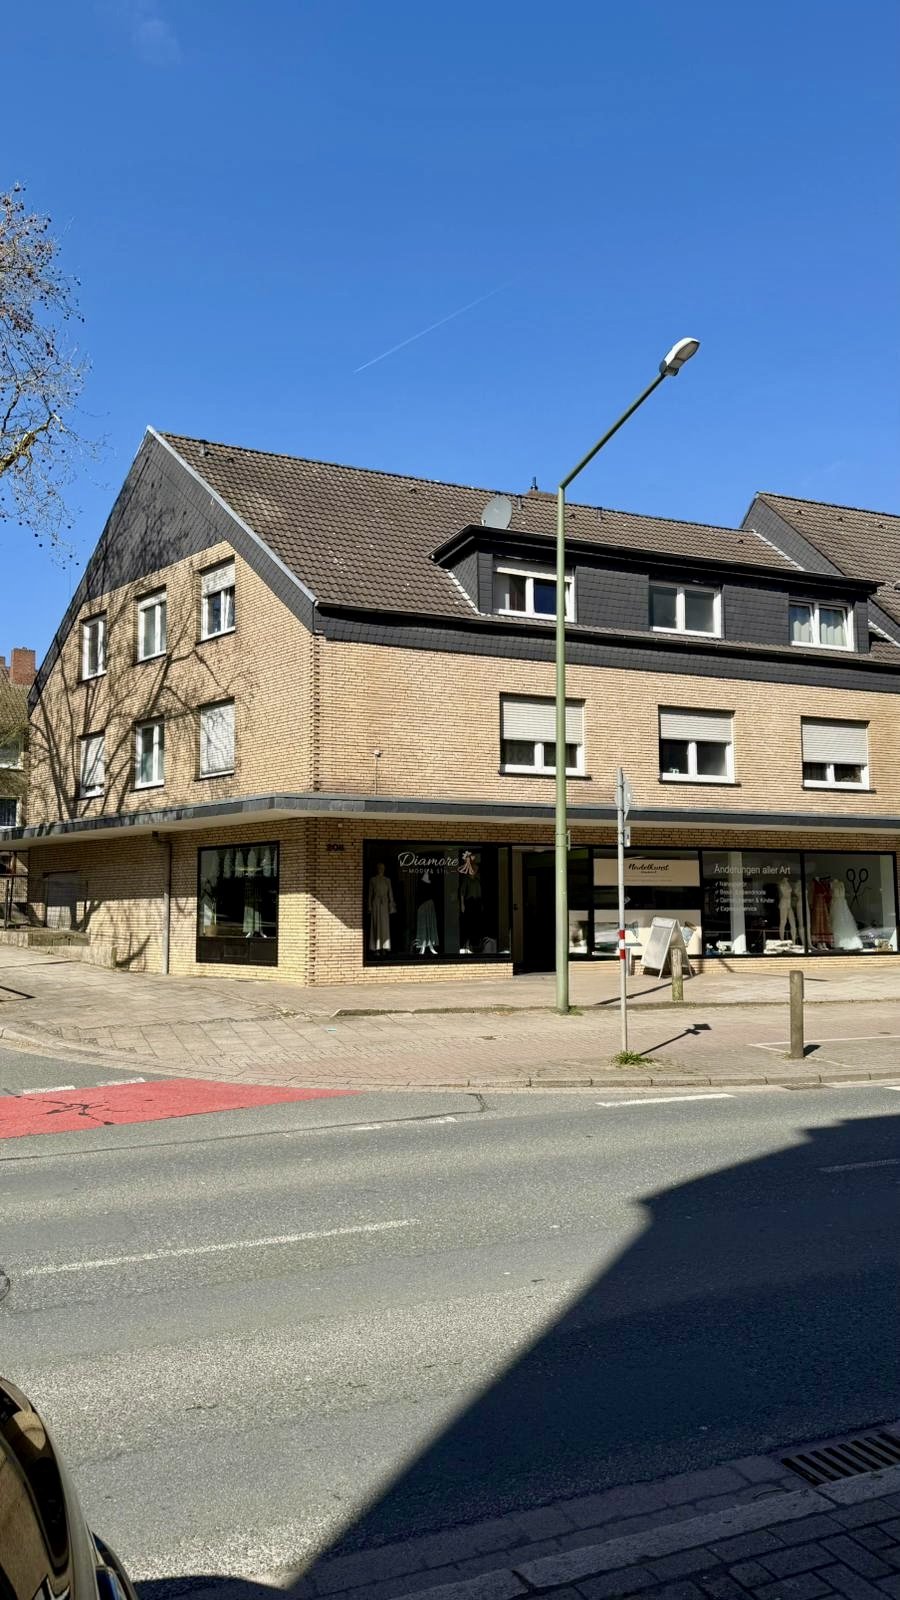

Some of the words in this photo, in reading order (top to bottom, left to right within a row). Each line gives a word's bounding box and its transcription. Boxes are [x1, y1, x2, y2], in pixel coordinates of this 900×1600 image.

[397, 851, 459, 867] Diamore
[628, 863, 670, 871] Nadelkunst
[714, 863, 760, 876] Änderungen
[762, 865, 778, 874] aller
[779, 865, 791, 874] Art
